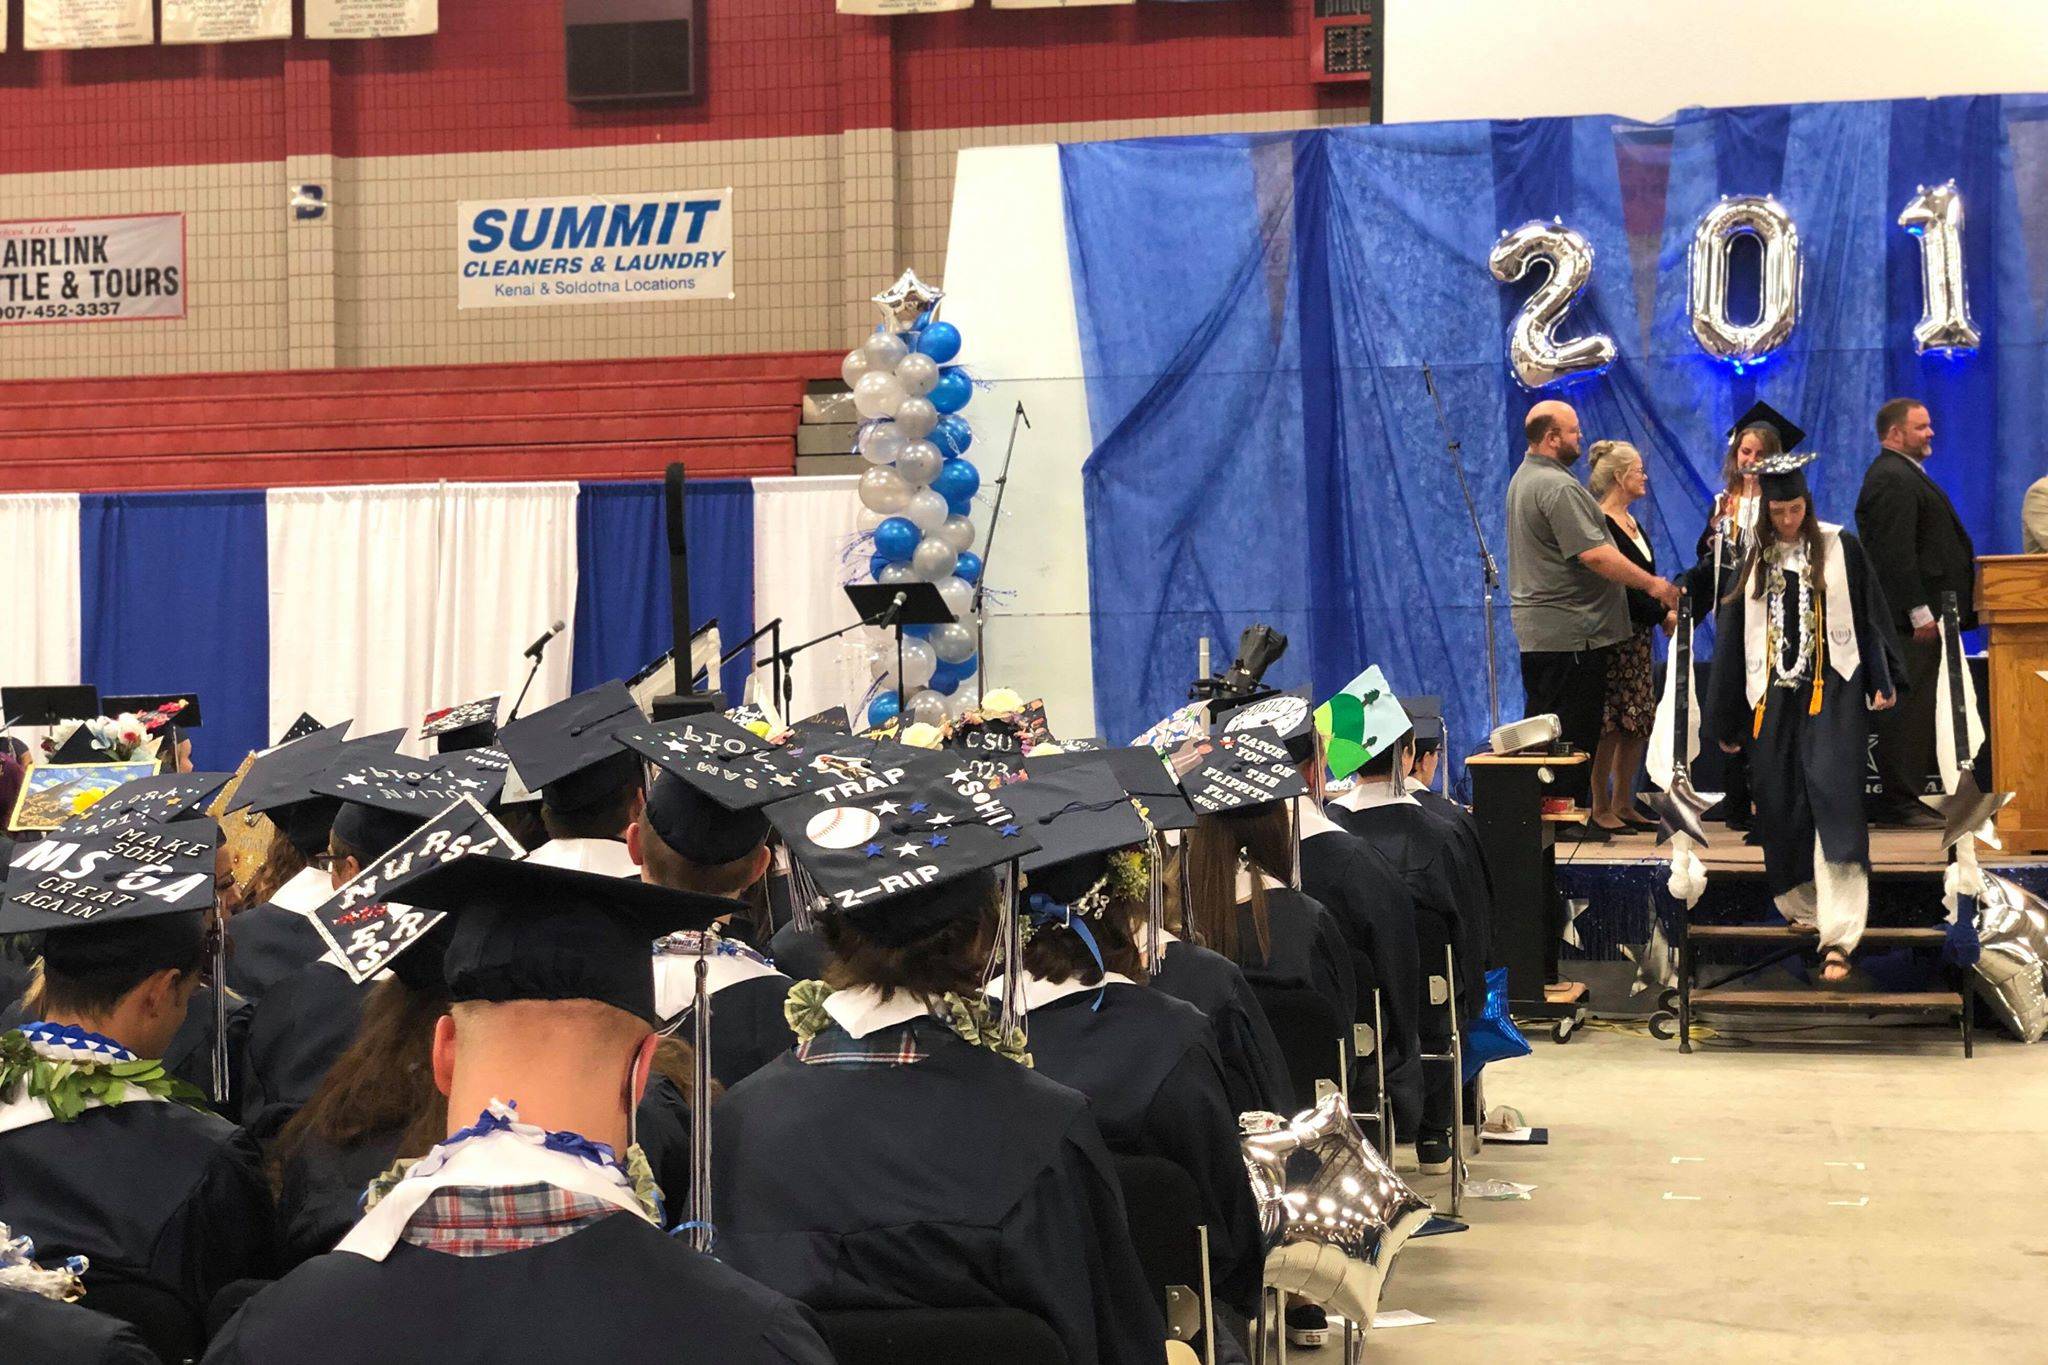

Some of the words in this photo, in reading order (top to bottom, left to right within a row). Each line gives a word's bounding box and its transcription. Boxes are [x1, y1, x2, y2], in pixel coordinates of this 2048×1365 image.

[467, 199, 721, 253] SUMMIT
[3, 235, 109, 268] AIRLINK
[463, 256, 583, 277] CLEANERS
[590, 256, 606, 272] &
[614, 250, 726, 272] LAUNDRY
[61, 270, 79, 299] &
[90, 266, 179, 299] TOURS
[495, 282, 534, 297] Kenai
[540, 283, 550, 295] &
[555, 280, 620, 295] Soldotna
[625, 276, 696, 292] Locations
[683, 724, 771, 764] 2019
[966, 731, 1012, 752] CSU
[1236, 733, 1288, 760] CATCH
[697, 761, 760, 790] SAM
[1235, 746, 1268, 765] YOU
[1270, 763, 1297, 779] ON
[814, 767, 905, 804] TRAP
[1201, 766, 1275, 803] FLIPPITY
[1245, 768, 1281, 789] THE
[111, 787, 179, 810] CORA
[957, 780, 1014, 827] SOHI
[1203, 784, 1242, 806] FLIP
[108, 842, 175, 866] SOHI
[116, 828, 211, 857] MAKE
[12, 890, 104, 920] AGAIN
[37, 876, 136, 907] GREAT
